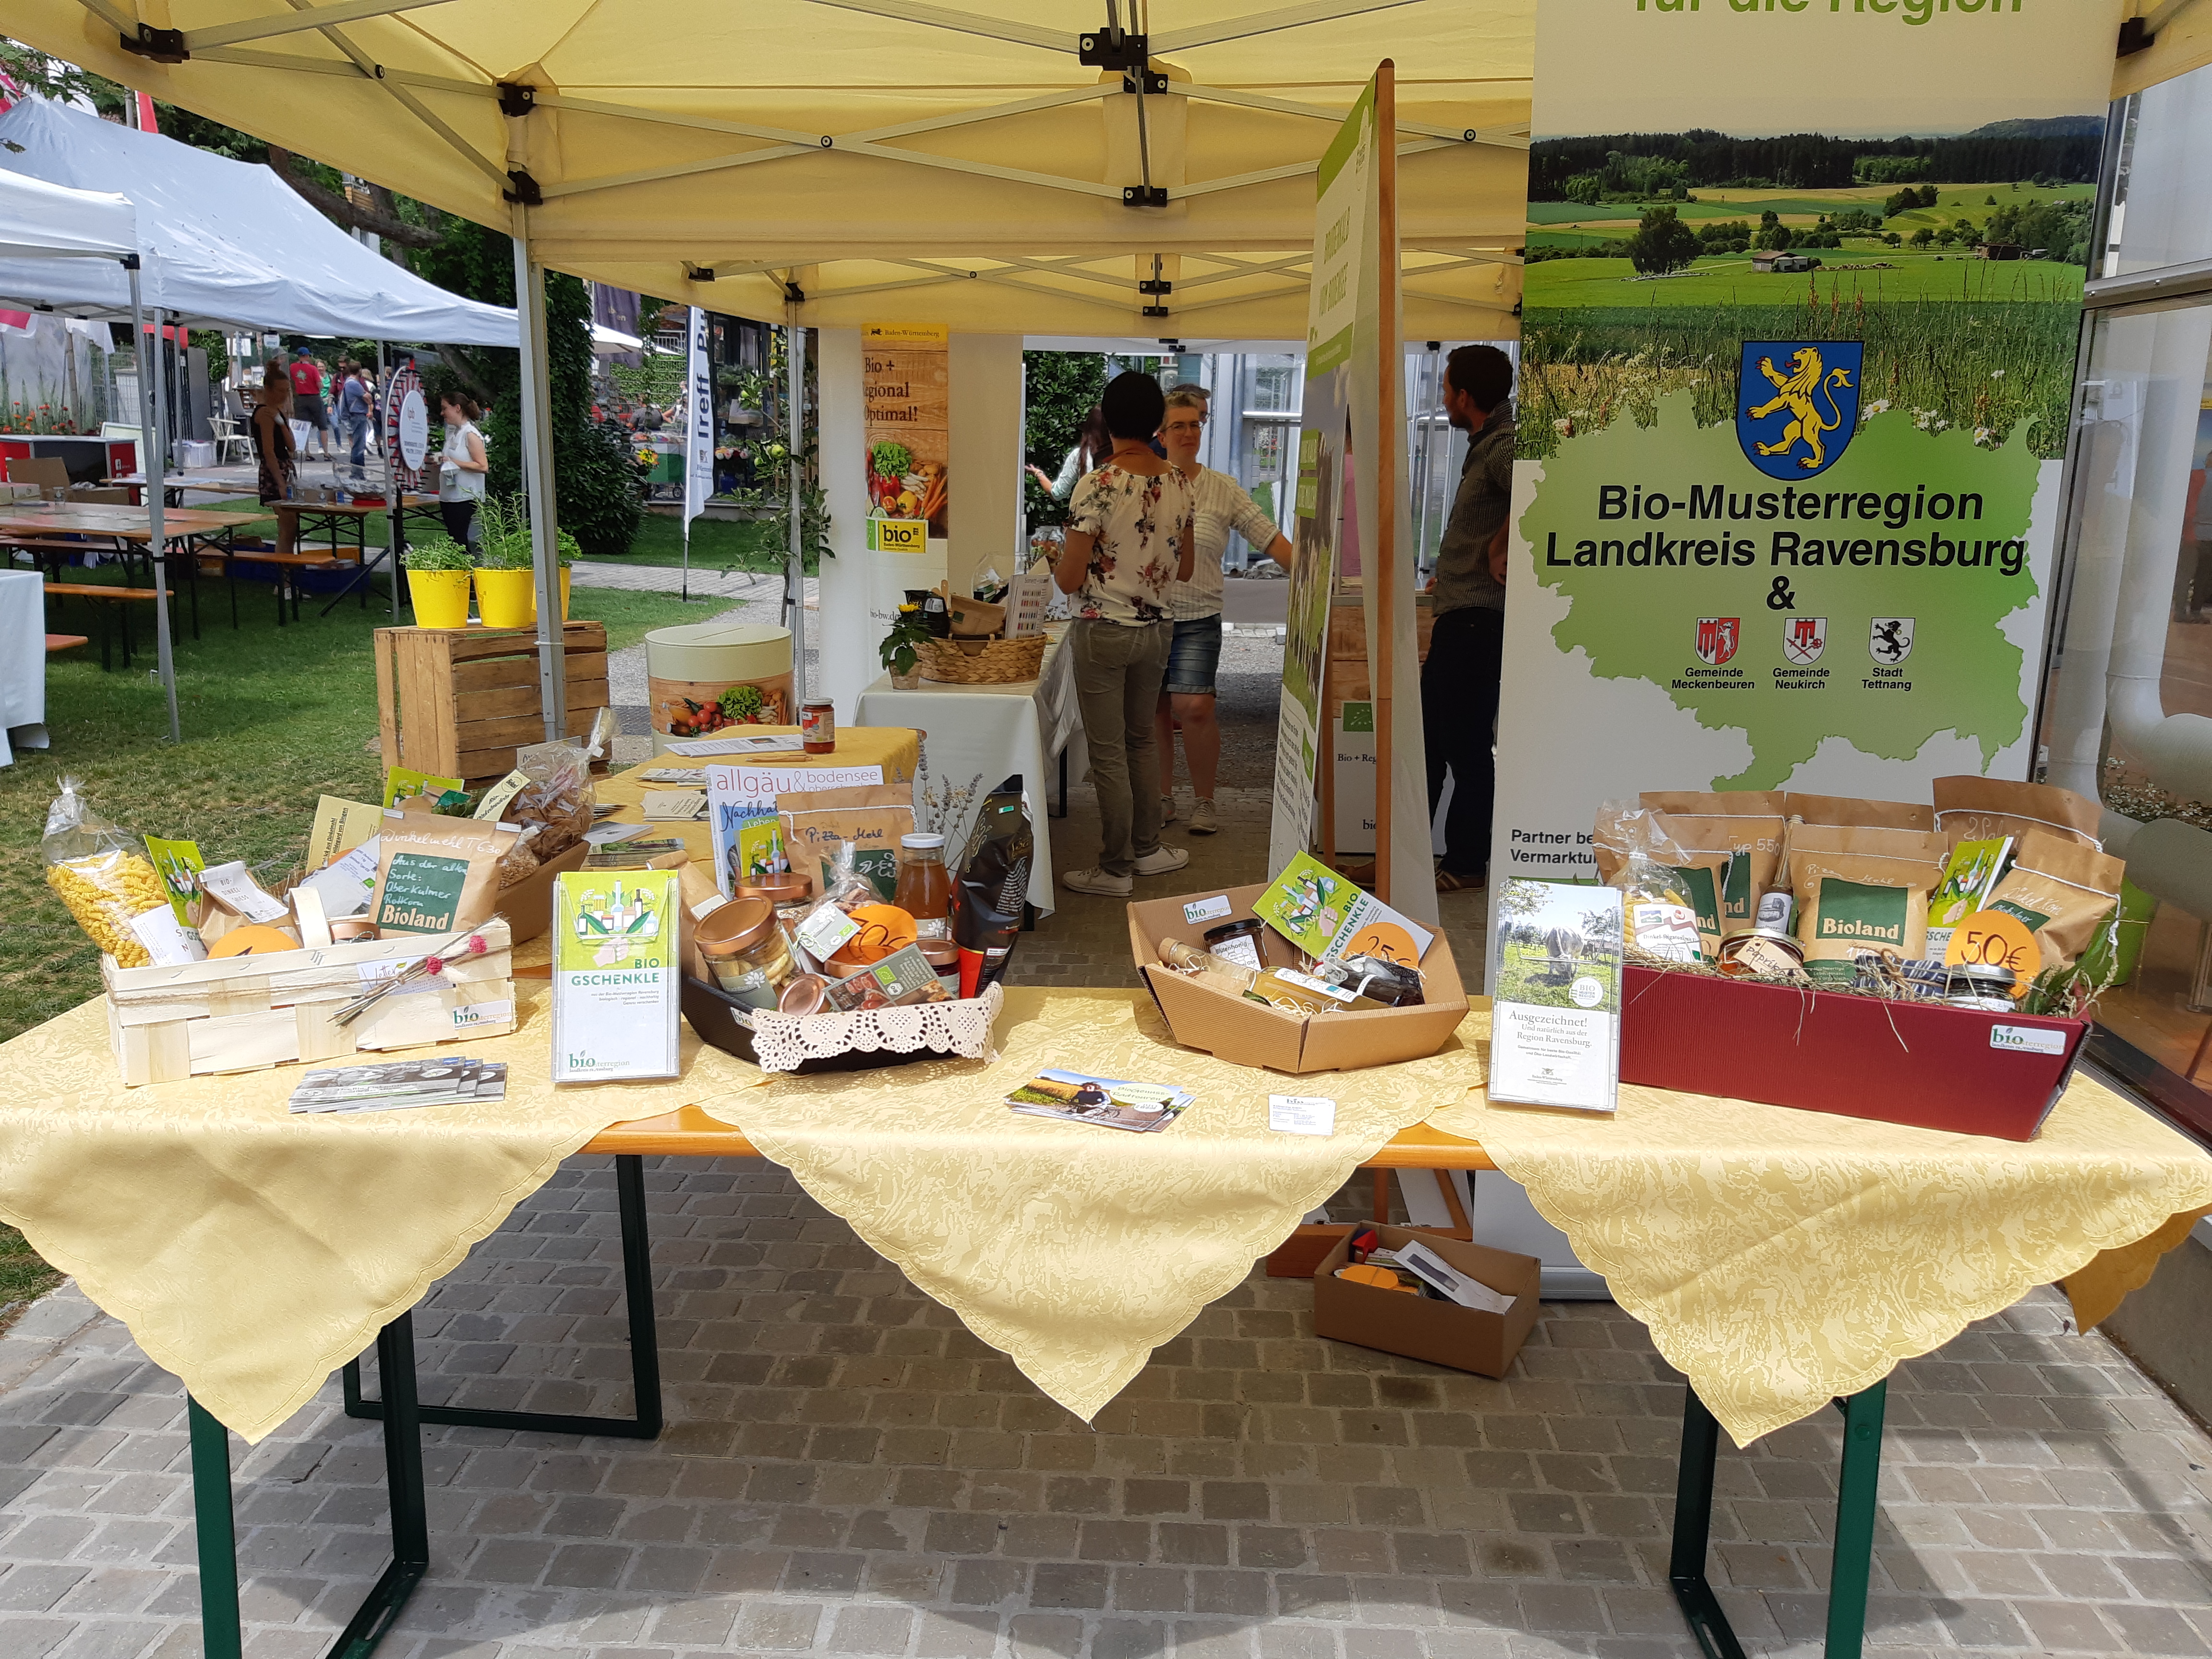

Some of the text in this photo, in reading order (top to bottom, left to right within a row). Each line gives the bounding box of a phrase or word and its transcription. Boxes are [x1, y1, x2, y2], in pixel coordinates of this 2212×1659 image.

[865, 357, 882, 373] Bio
[863, 381, 911, 403] egional
[697, 373, 709, 439] Treff
[864, 405, 918, 427] Optimal!
[1598, 484, 1984, 529] Bio-Musterregion
[882, 524, 912, 543] bio
[1546, 531, 2026, 577] Landkreis Ravensburg
[1767, 576, 1796, 611] &
[1685, 667, 1743, 678] Gemeinde
[1773, 667, 1830, 678] Gemeinde
[1872, 667, 1903, 678] Stadt
[1671, 679, 1755, 689] Meckenbeuren
[1775, 679, 1826, 689] Neukirch
[1862, 679, 1912, 692] Tettnang
[1337, 754, 1352, 762] Bio
[717, 769, 791, 798] allgäu
[793, 771, 806, 793] &
[806, 770, 878, 784] bodensee
[1511, 829, 1572, 845] Partner
[392, 854, 416, 866] Aus
[419, 860, 438, 869] der
[1185, 903, 1207, 920] bio
[1343, 893, 1359, 913] BIO
[381, 904, 450, 930] Bioland
[1822, 918, 1899, 940] Bioland
[1215, 941, 1248, 955] Blütenhonig
[1960, 931, 2027, 973] 50€
[635, 958, 660, 969] BIO
[571, 973, 660, 986] GSCHENKLE
[453, 1006, 479, 1024] bio
[1508, 1010, 1587, 1027] Ausgezeichnet!
[1522, 1023, 1536, 1032] Und
[1993, 1027, 2024, 1045] bio
[1516, 1032, 1592, 1048] Region Ravensburg.
[568, 1050, 596, 1068] bio
